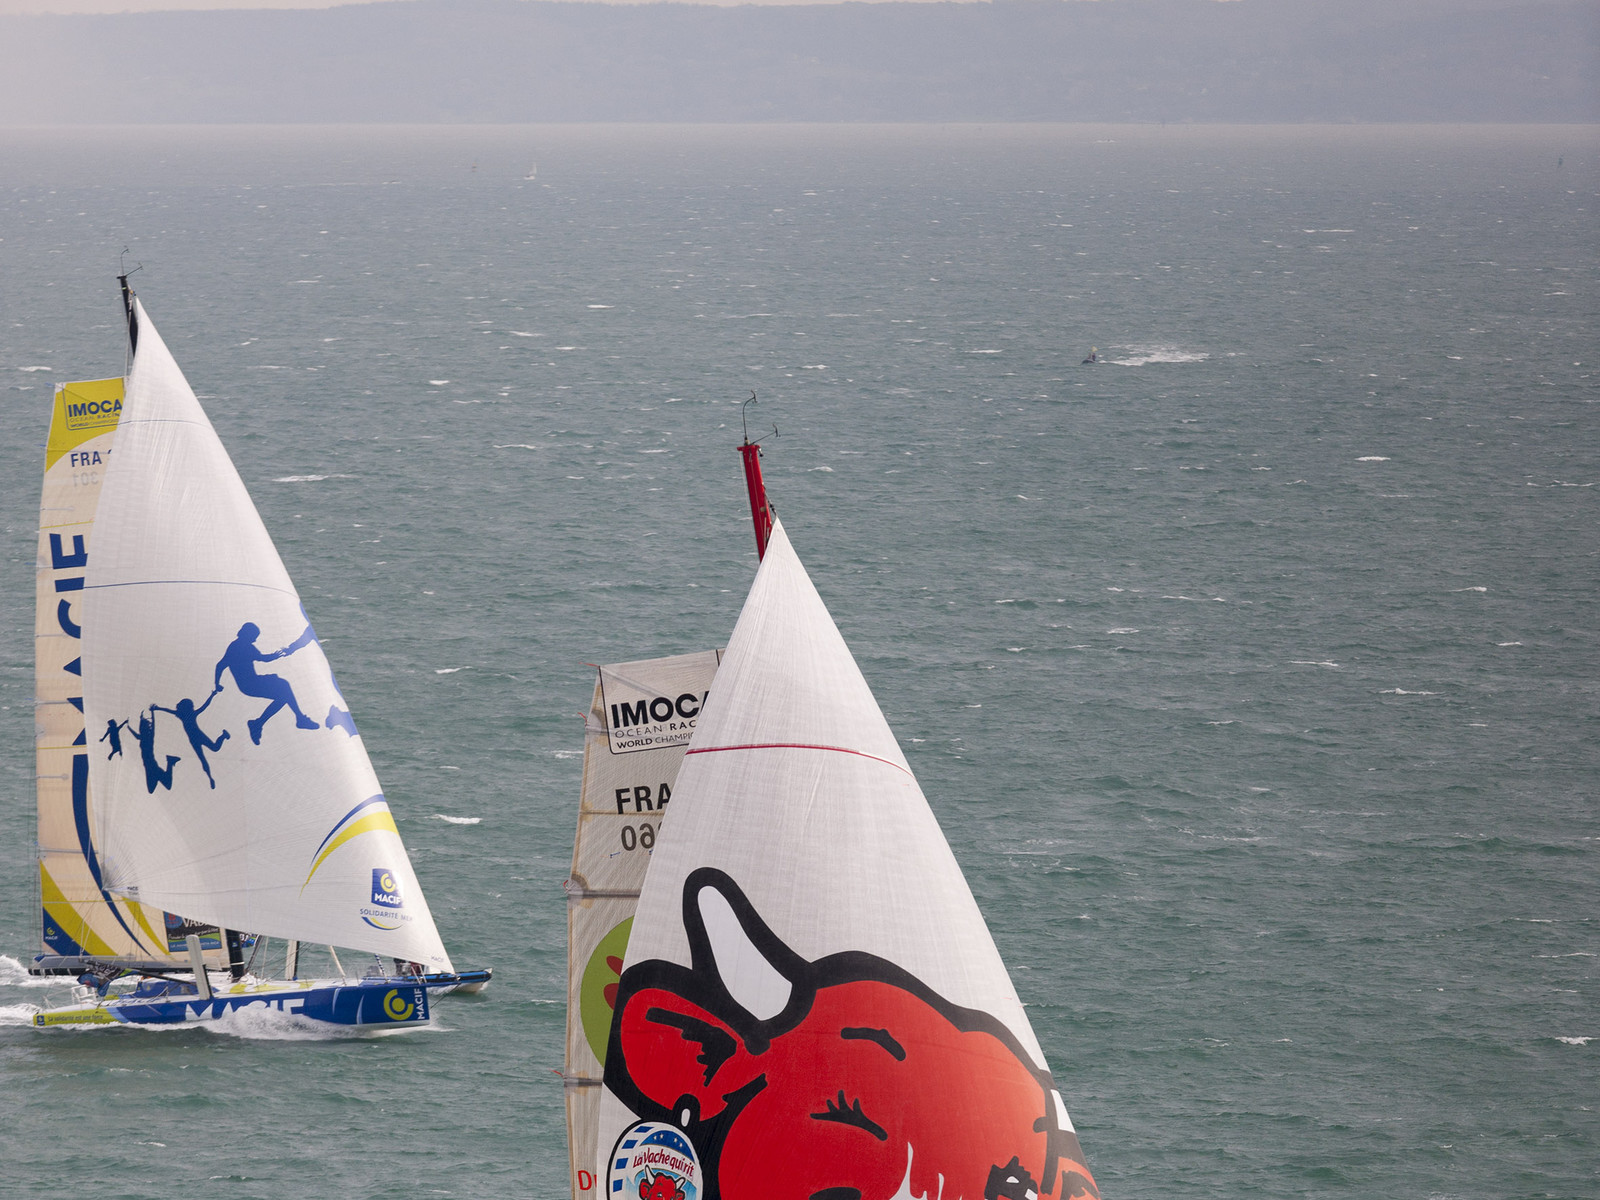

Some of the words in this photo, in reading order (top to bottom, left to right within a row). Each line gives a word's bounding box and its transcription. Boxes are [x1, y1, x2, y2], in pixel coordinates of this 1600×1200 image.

[68, 399, 122, 417] IMOCA
[70, 451, 102, 467] FRA
[611, 691, 709, 728] IMOC
[615, 725, 663, 738] OCEAN
[670, 720, 697, 731] RAC
[617, 738, 653, 749] WORLD
[615, 783, 671, 814] FRA
[374, 893, 401, 905] MACIF
[413, 988, 425, 1020] MACIF
[633, 1155, 642, 1168] La
[644, 1147, 670, 1165] Vache
[669, 1156, 684, 1171] qui
[684, 1162, 694, 1177] rit
